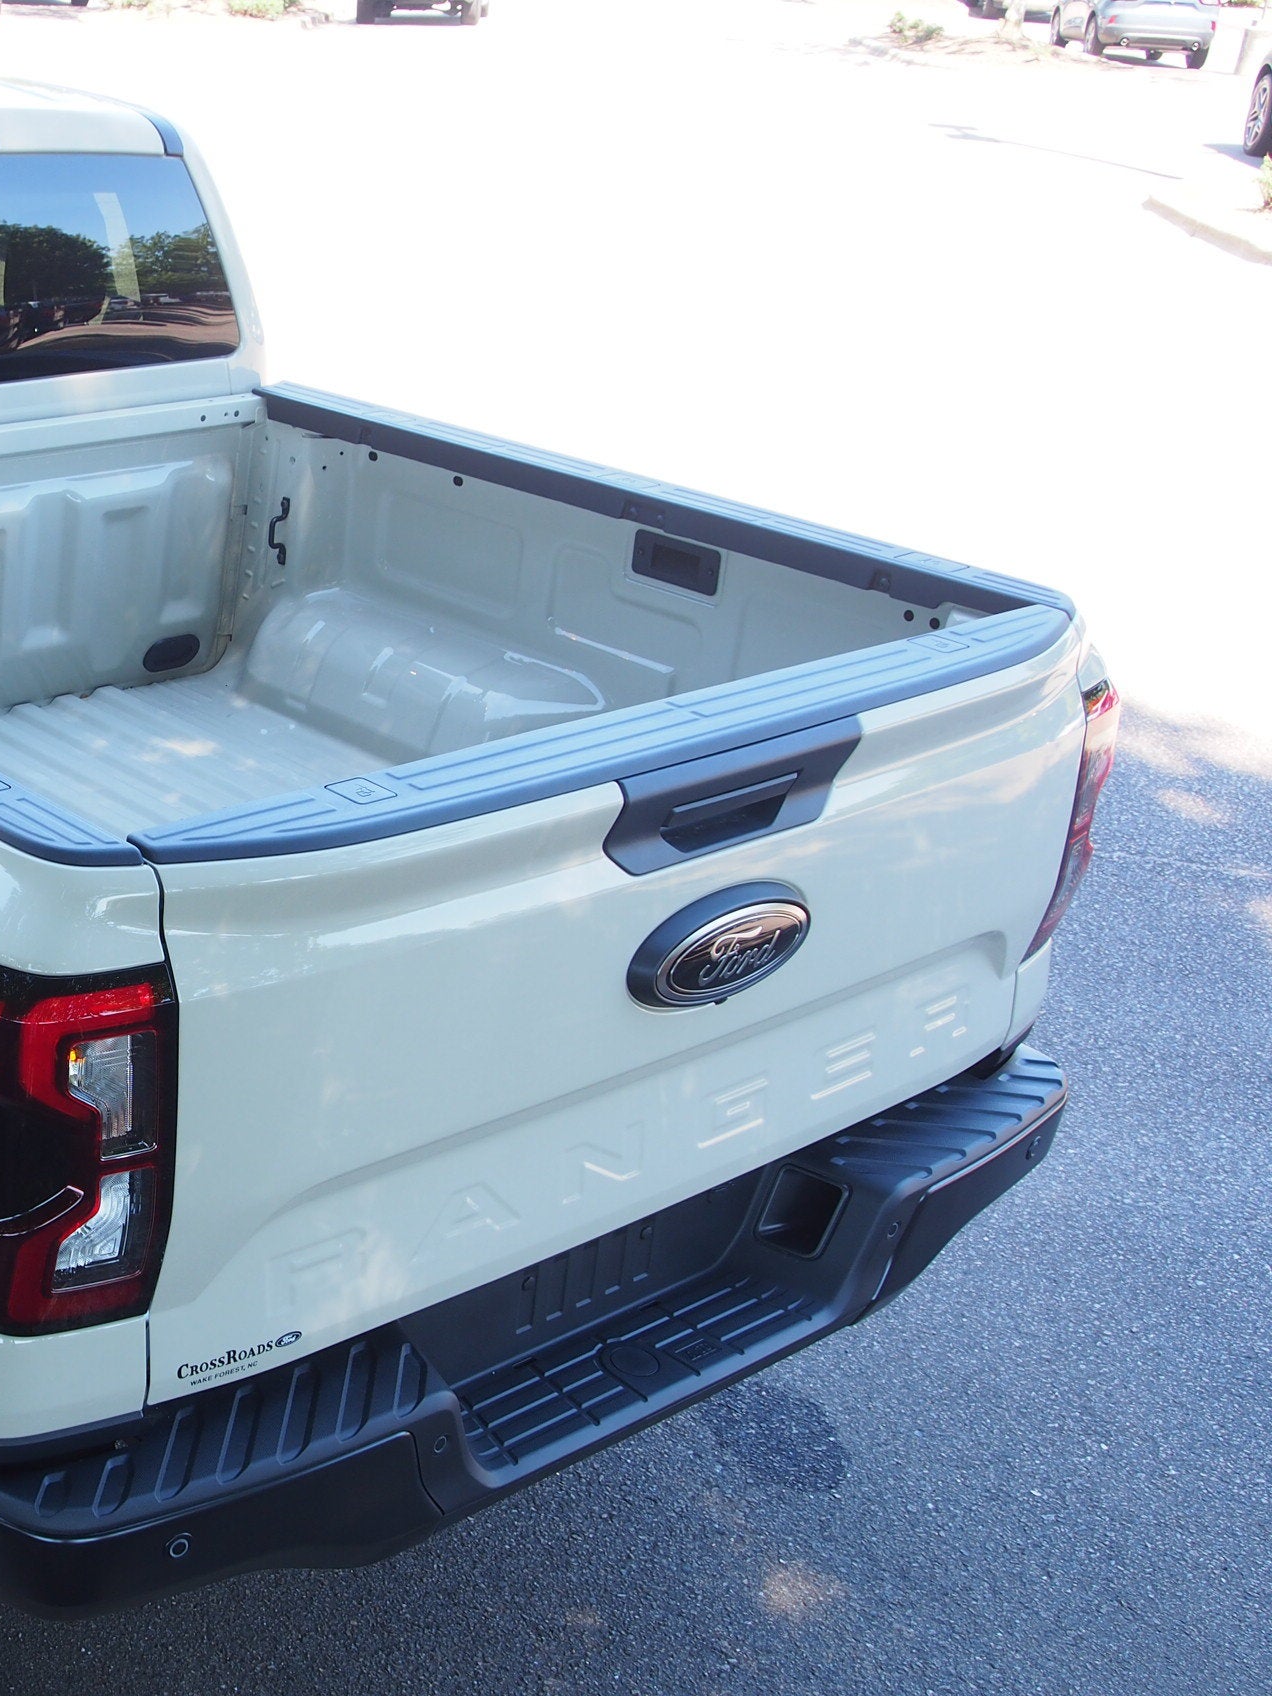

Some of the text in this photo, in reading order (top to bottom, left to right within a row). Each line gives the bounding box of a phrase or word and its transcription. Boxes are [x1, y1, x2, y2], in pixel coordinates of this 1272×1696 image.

[697, 925, 781, 987] Ford
[263, 993, 969, 1320] RANGER
[190, 1361, 259, 1387] WAKE FOREST, NC
